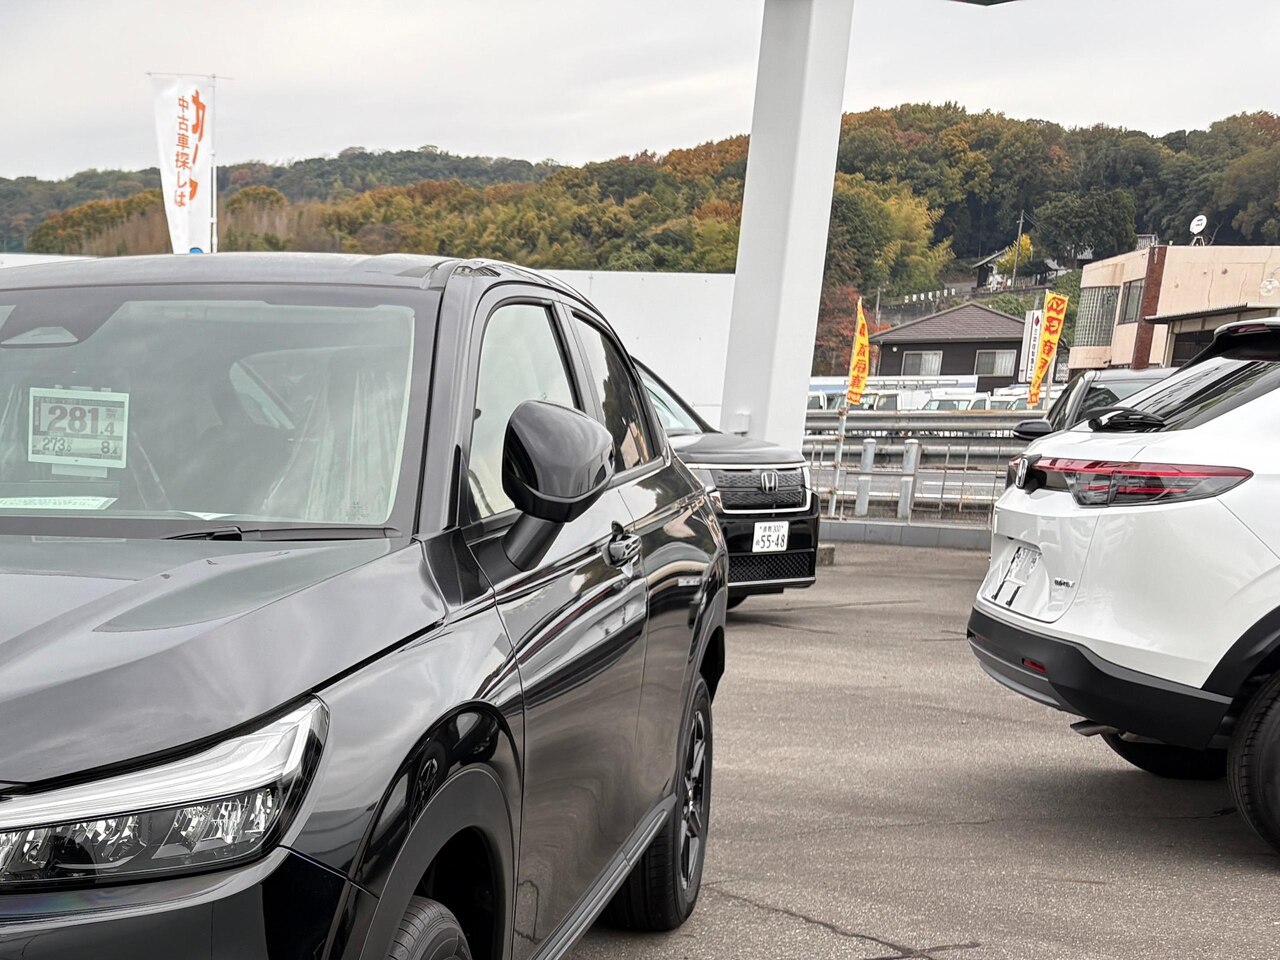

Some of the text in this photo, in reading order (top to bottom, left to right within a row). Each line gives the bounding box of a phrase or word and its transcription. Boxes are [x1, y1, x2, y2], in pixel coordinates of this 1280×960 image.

[175, 96, 190, 208] 中古車探しは
